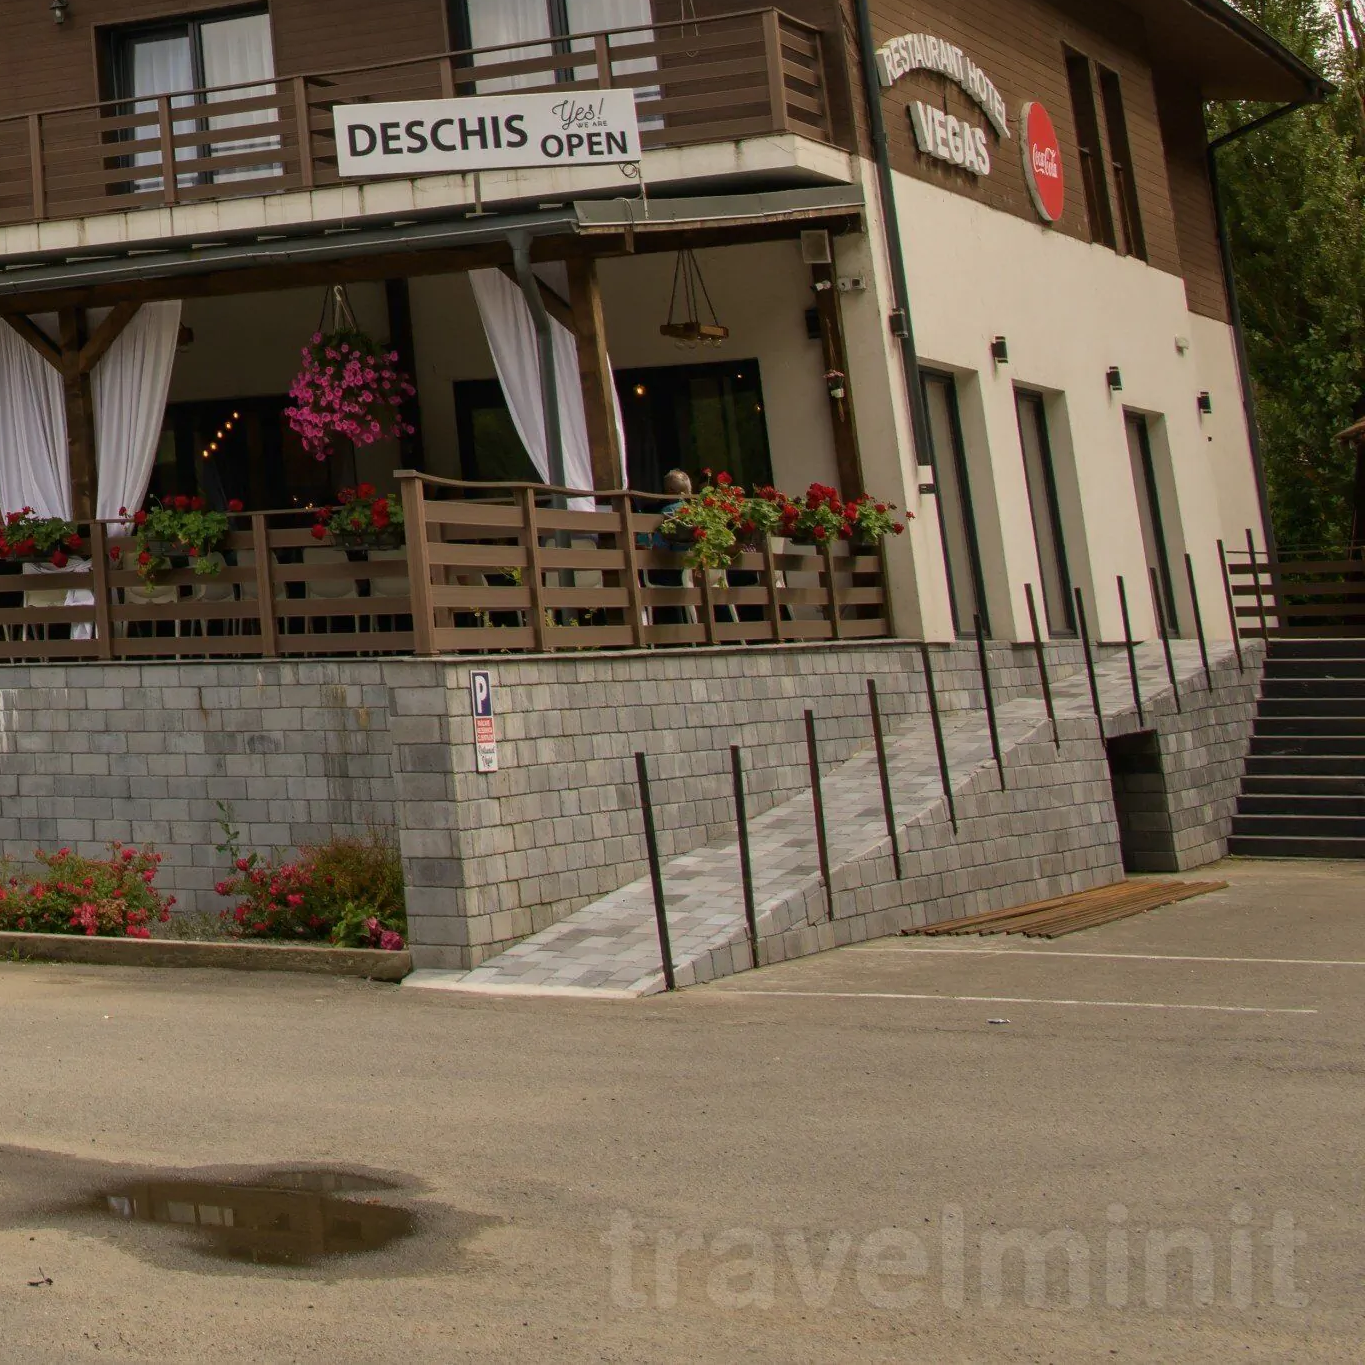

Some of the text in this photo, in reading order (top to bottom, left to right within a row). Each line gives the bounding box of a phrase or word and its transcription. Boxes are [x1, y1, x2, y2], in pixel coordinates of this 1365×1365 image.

[879, 33, 1010, 138] RESTAURANT HOTEL
[552, 98, 604, 130] Yes!
[576, 121, 589, 129] WE
[347, 114, 528, 157] DESCHIS
[541, 131, 628, 158] OPEN
[910, 100, 990, 175] VEGAS
[474, 675, 487, 714] P
